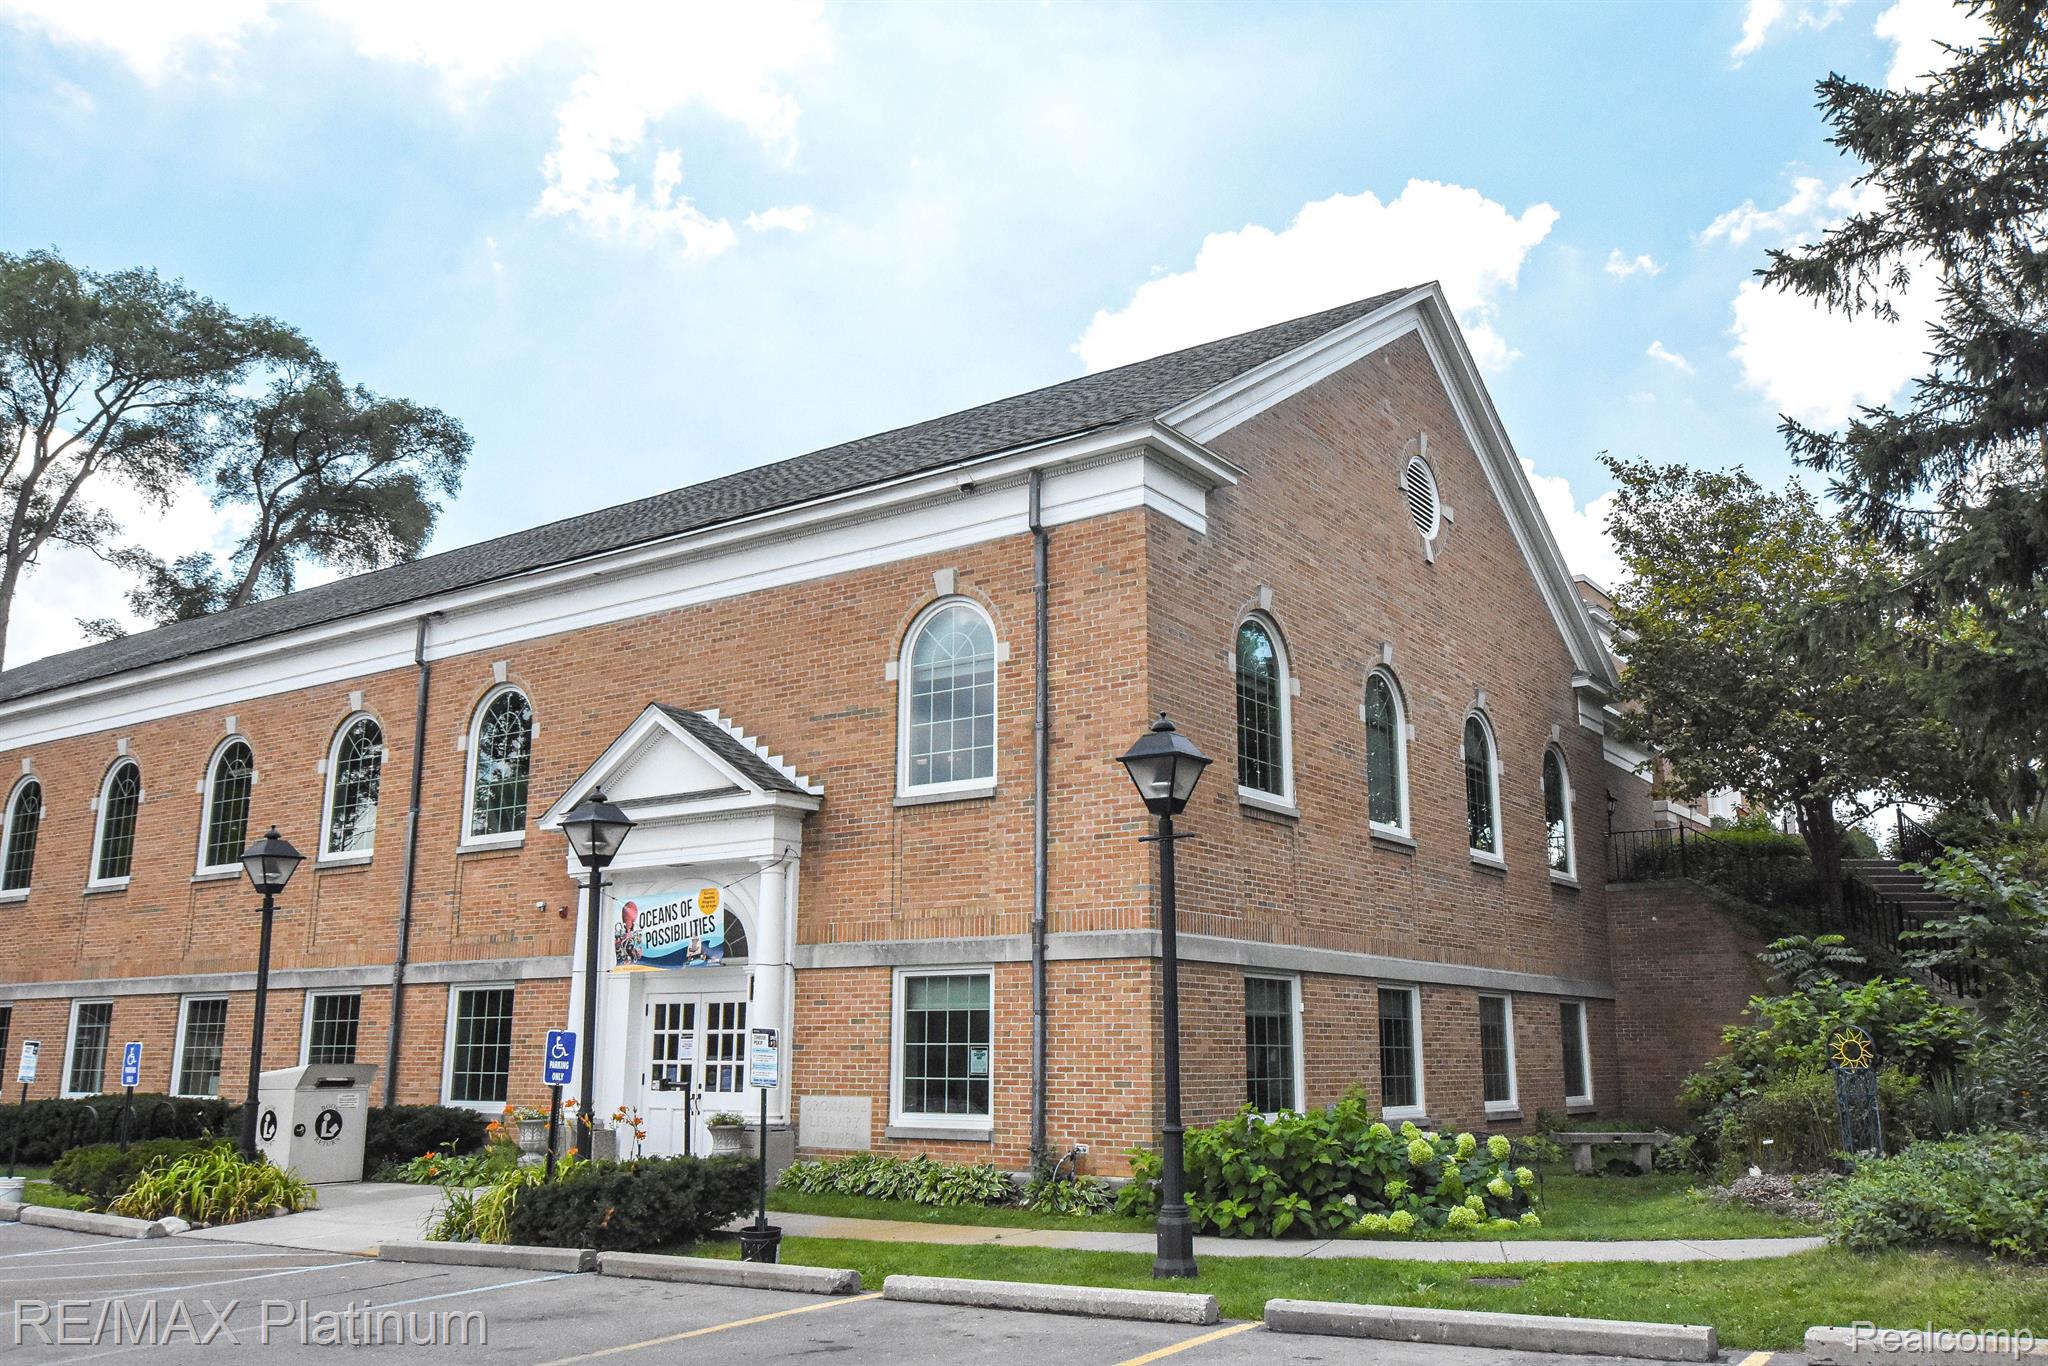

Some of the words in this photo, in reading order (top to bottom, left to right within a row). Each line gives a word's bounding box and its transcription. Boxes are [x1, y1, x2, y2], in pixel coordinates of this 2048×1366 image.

[639, 902, 678, 929] OCEANS
[680, 898, 693, 918] OF
[645, 915, 716, 949] POSSIBILITIES
[549, 1060, 569, 1069] PARKING
[809, 1115, 862, 1129] LIBRARY
